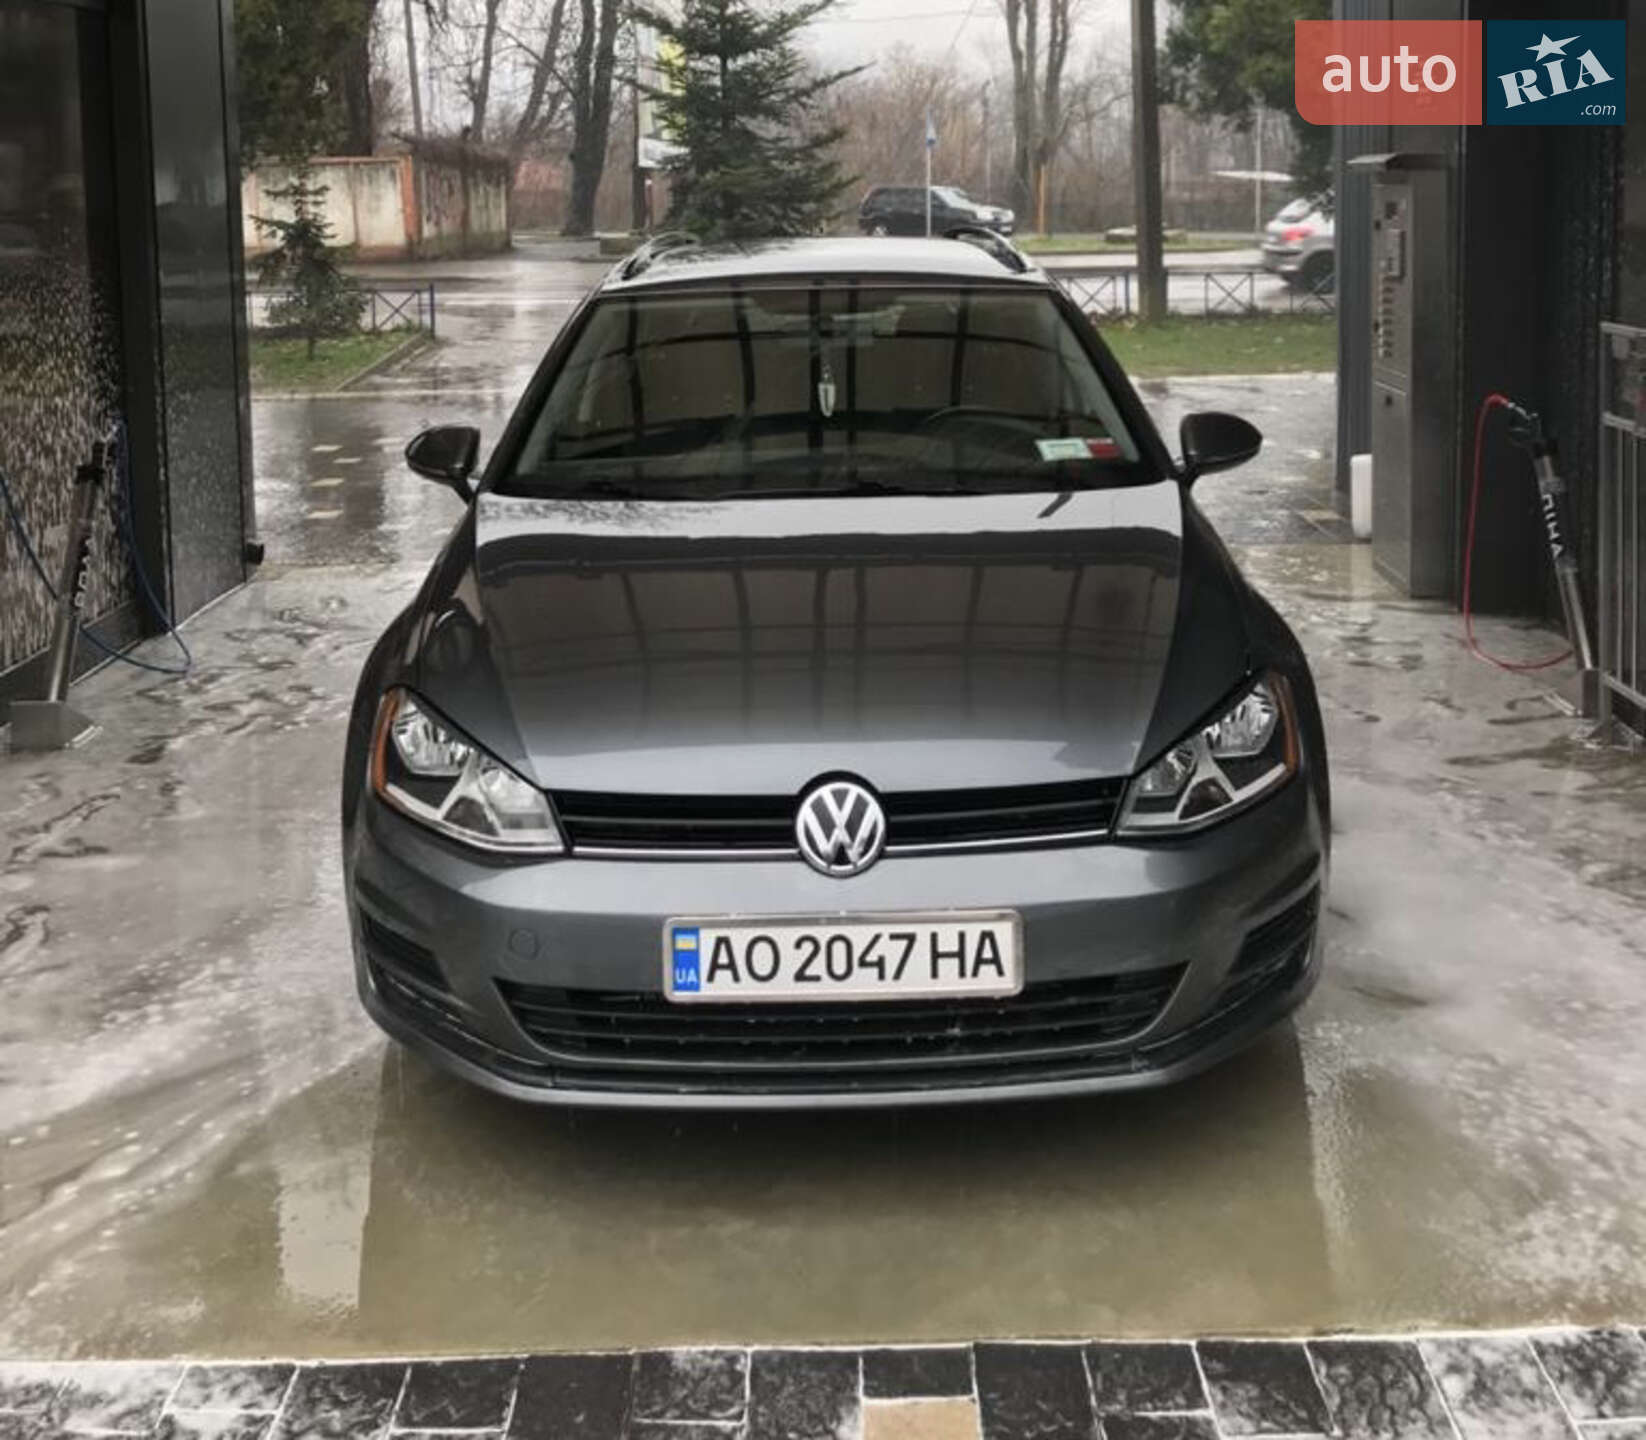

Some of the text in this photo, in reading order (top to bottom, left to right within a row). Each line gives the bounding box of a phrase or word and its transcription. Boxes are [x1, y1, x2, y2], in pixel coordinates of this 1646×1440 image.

[706, 930, 1006, 983] AO 2047 HA
[675, 969, 698, 984] UA
